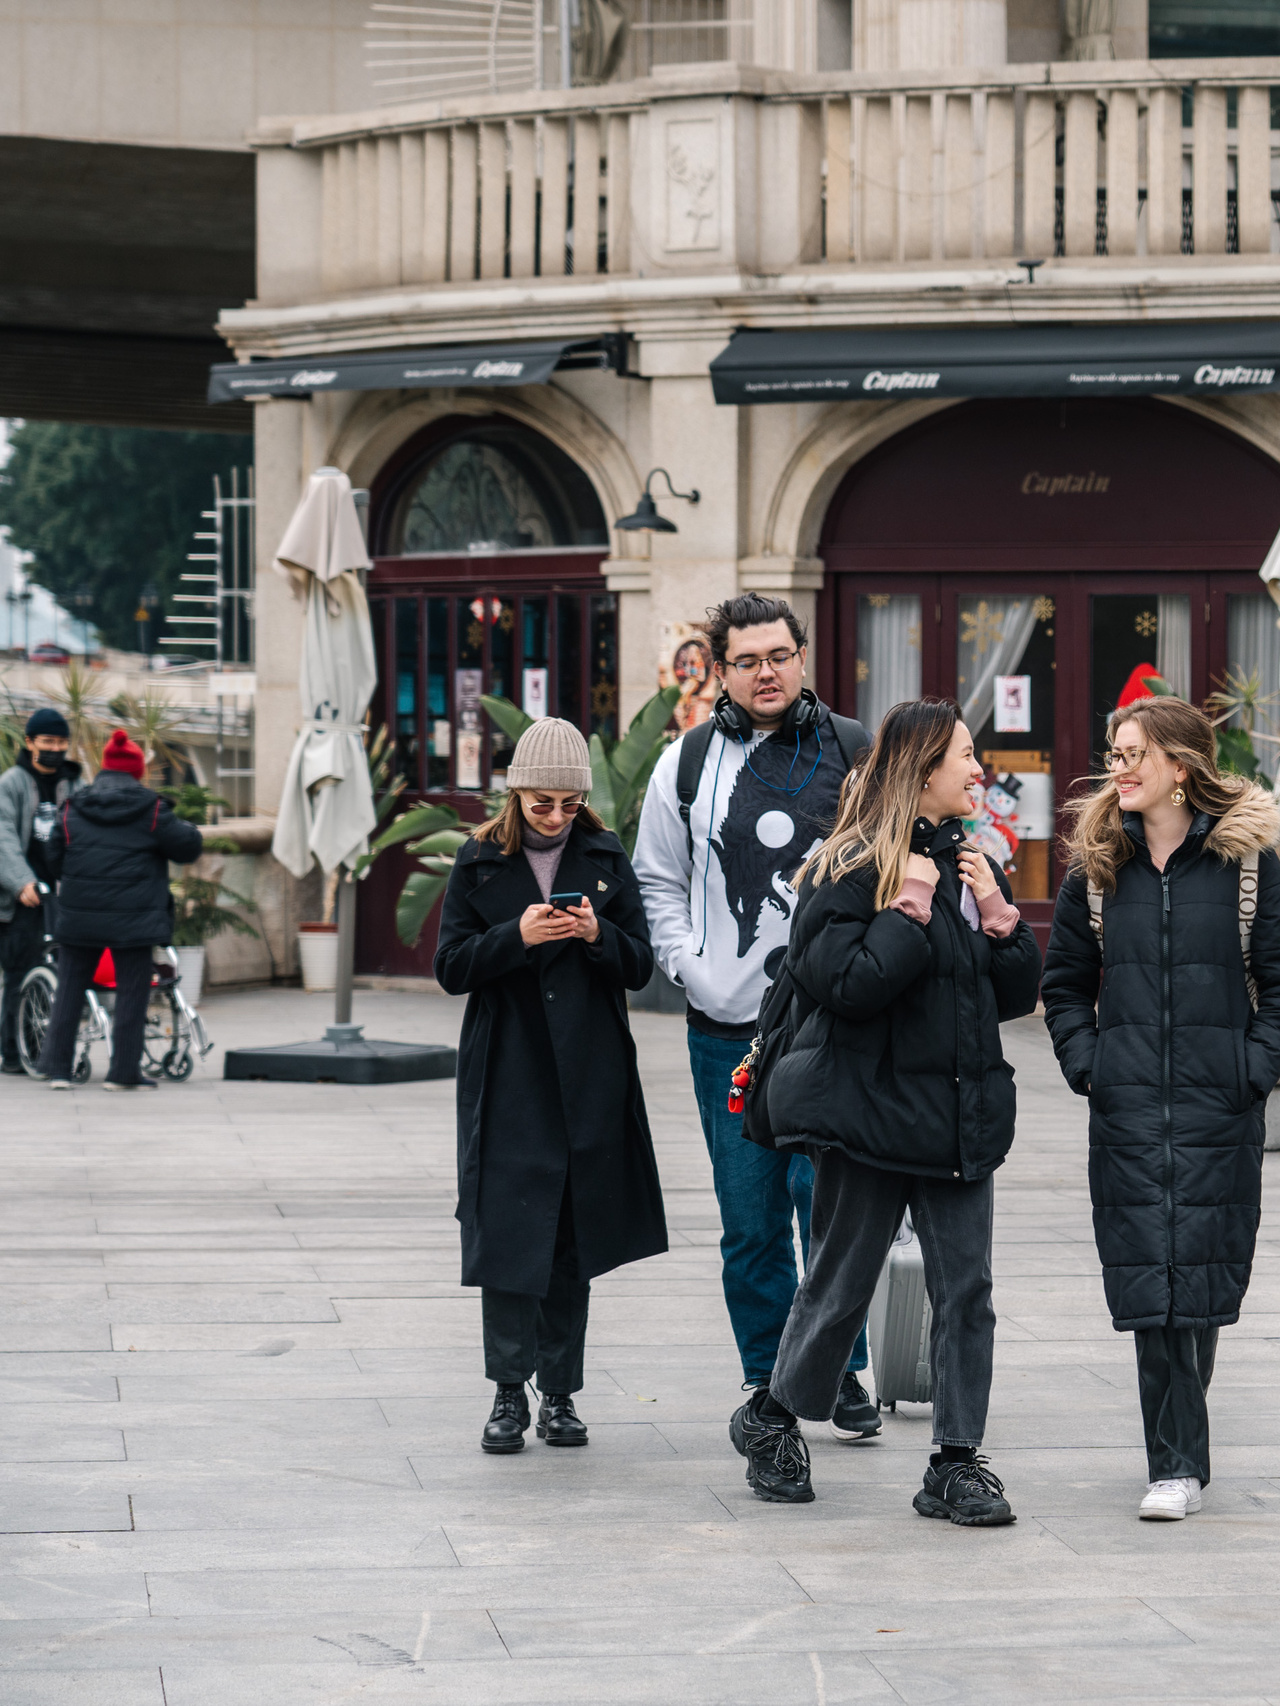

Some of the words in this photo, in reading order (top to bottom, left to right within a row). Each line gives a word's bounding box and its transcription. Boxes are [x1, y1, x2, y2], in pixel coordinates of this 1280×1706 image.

[863, 371, 940, 391] Captain
[1194, 365, 1275, 386] Captain
[1021, 470, 1110, 497] Captain
